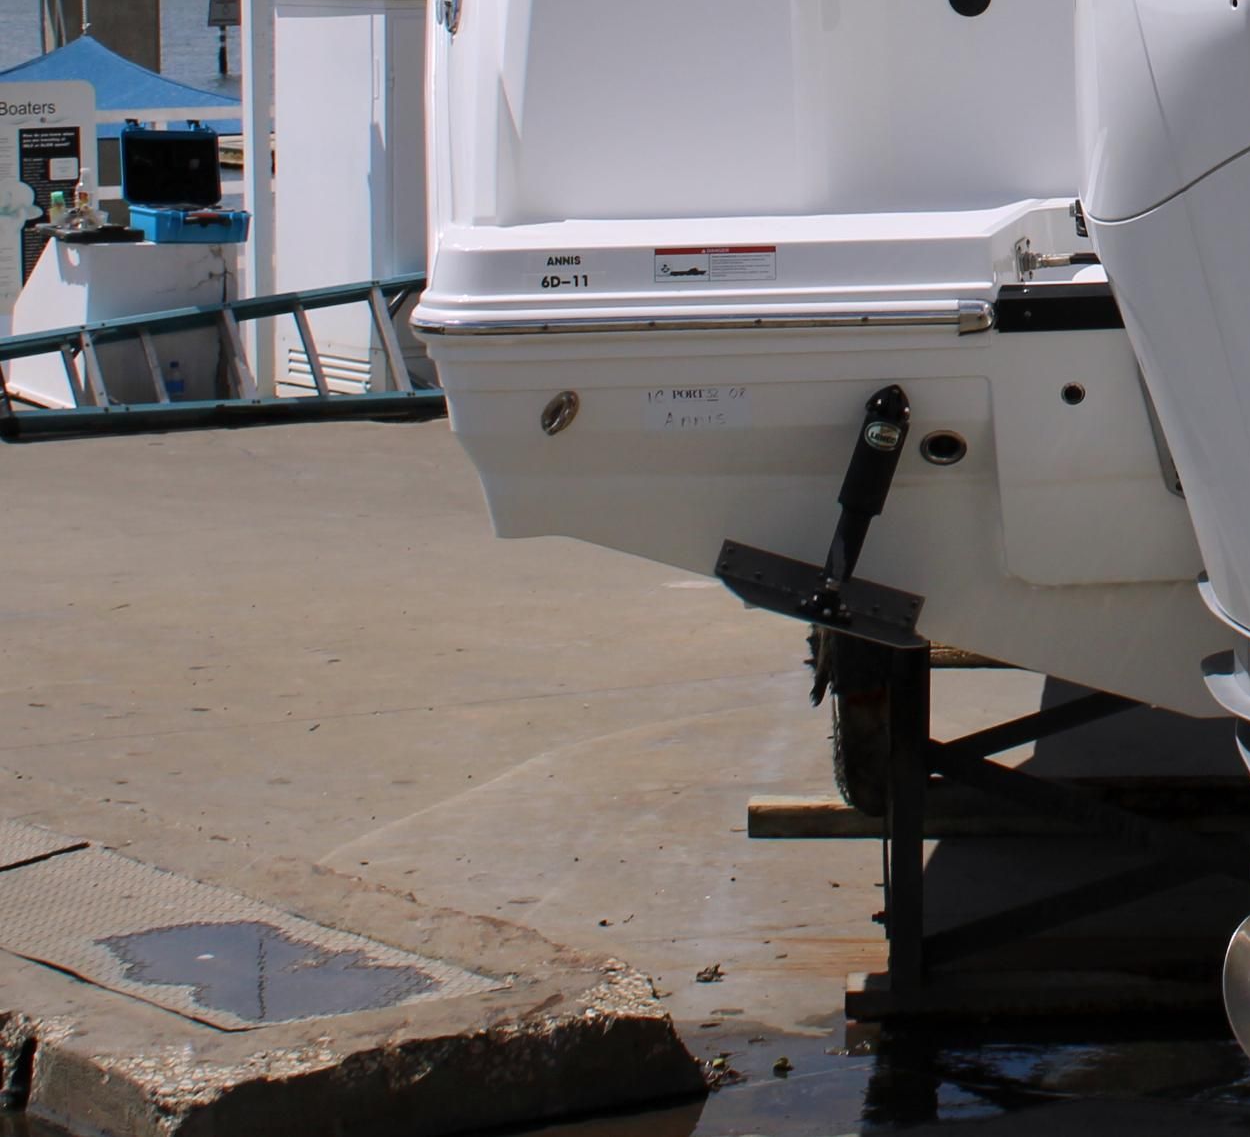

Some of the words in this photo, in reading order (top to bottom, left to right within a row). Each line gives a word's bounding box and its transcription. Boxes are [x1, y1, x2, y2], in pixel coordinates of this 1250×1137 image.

[0, 101, 56, 116] Boaters
[546, 255, 582, 266] ANNIS
[541, 274, 589, 288] 6D-11
[672, 389, 704, 399] PORT
